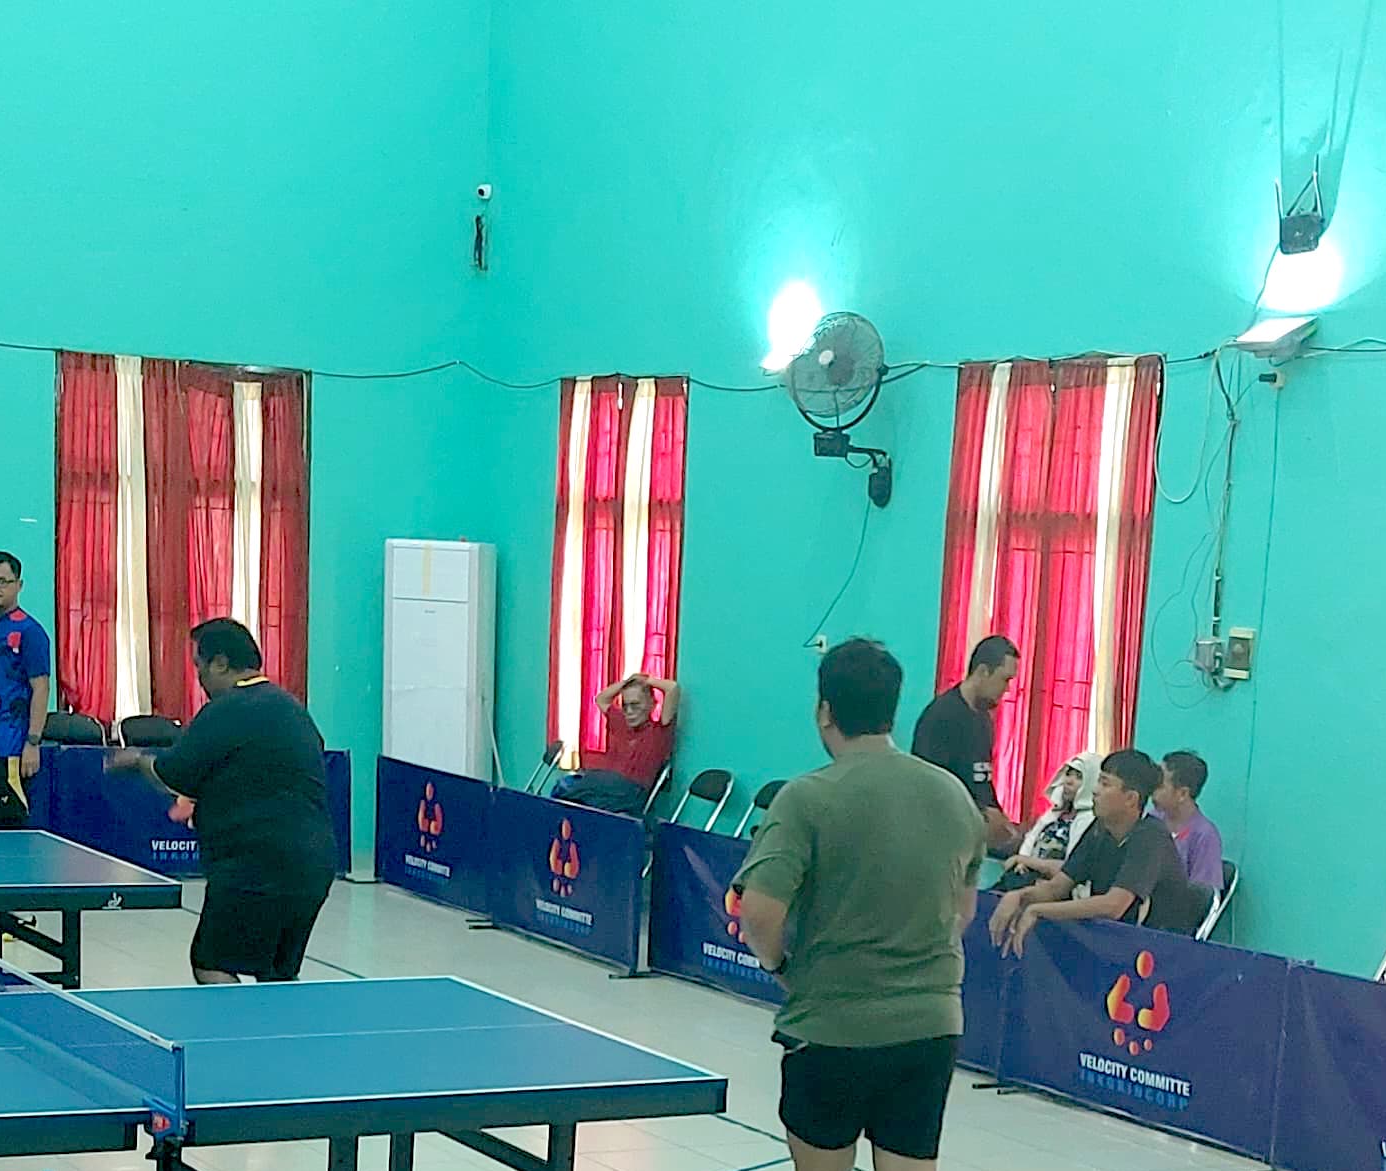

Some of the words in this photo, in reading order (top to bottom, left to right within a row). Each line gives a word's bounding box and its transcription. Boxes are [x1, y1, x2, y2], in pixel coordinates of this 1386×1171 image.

[151, 839, 199, 851] VELOCIT
[1079, 1052, 1129, 1079] VELOCITY
[1129, 1067, 1191, 1097] COMMITTE
